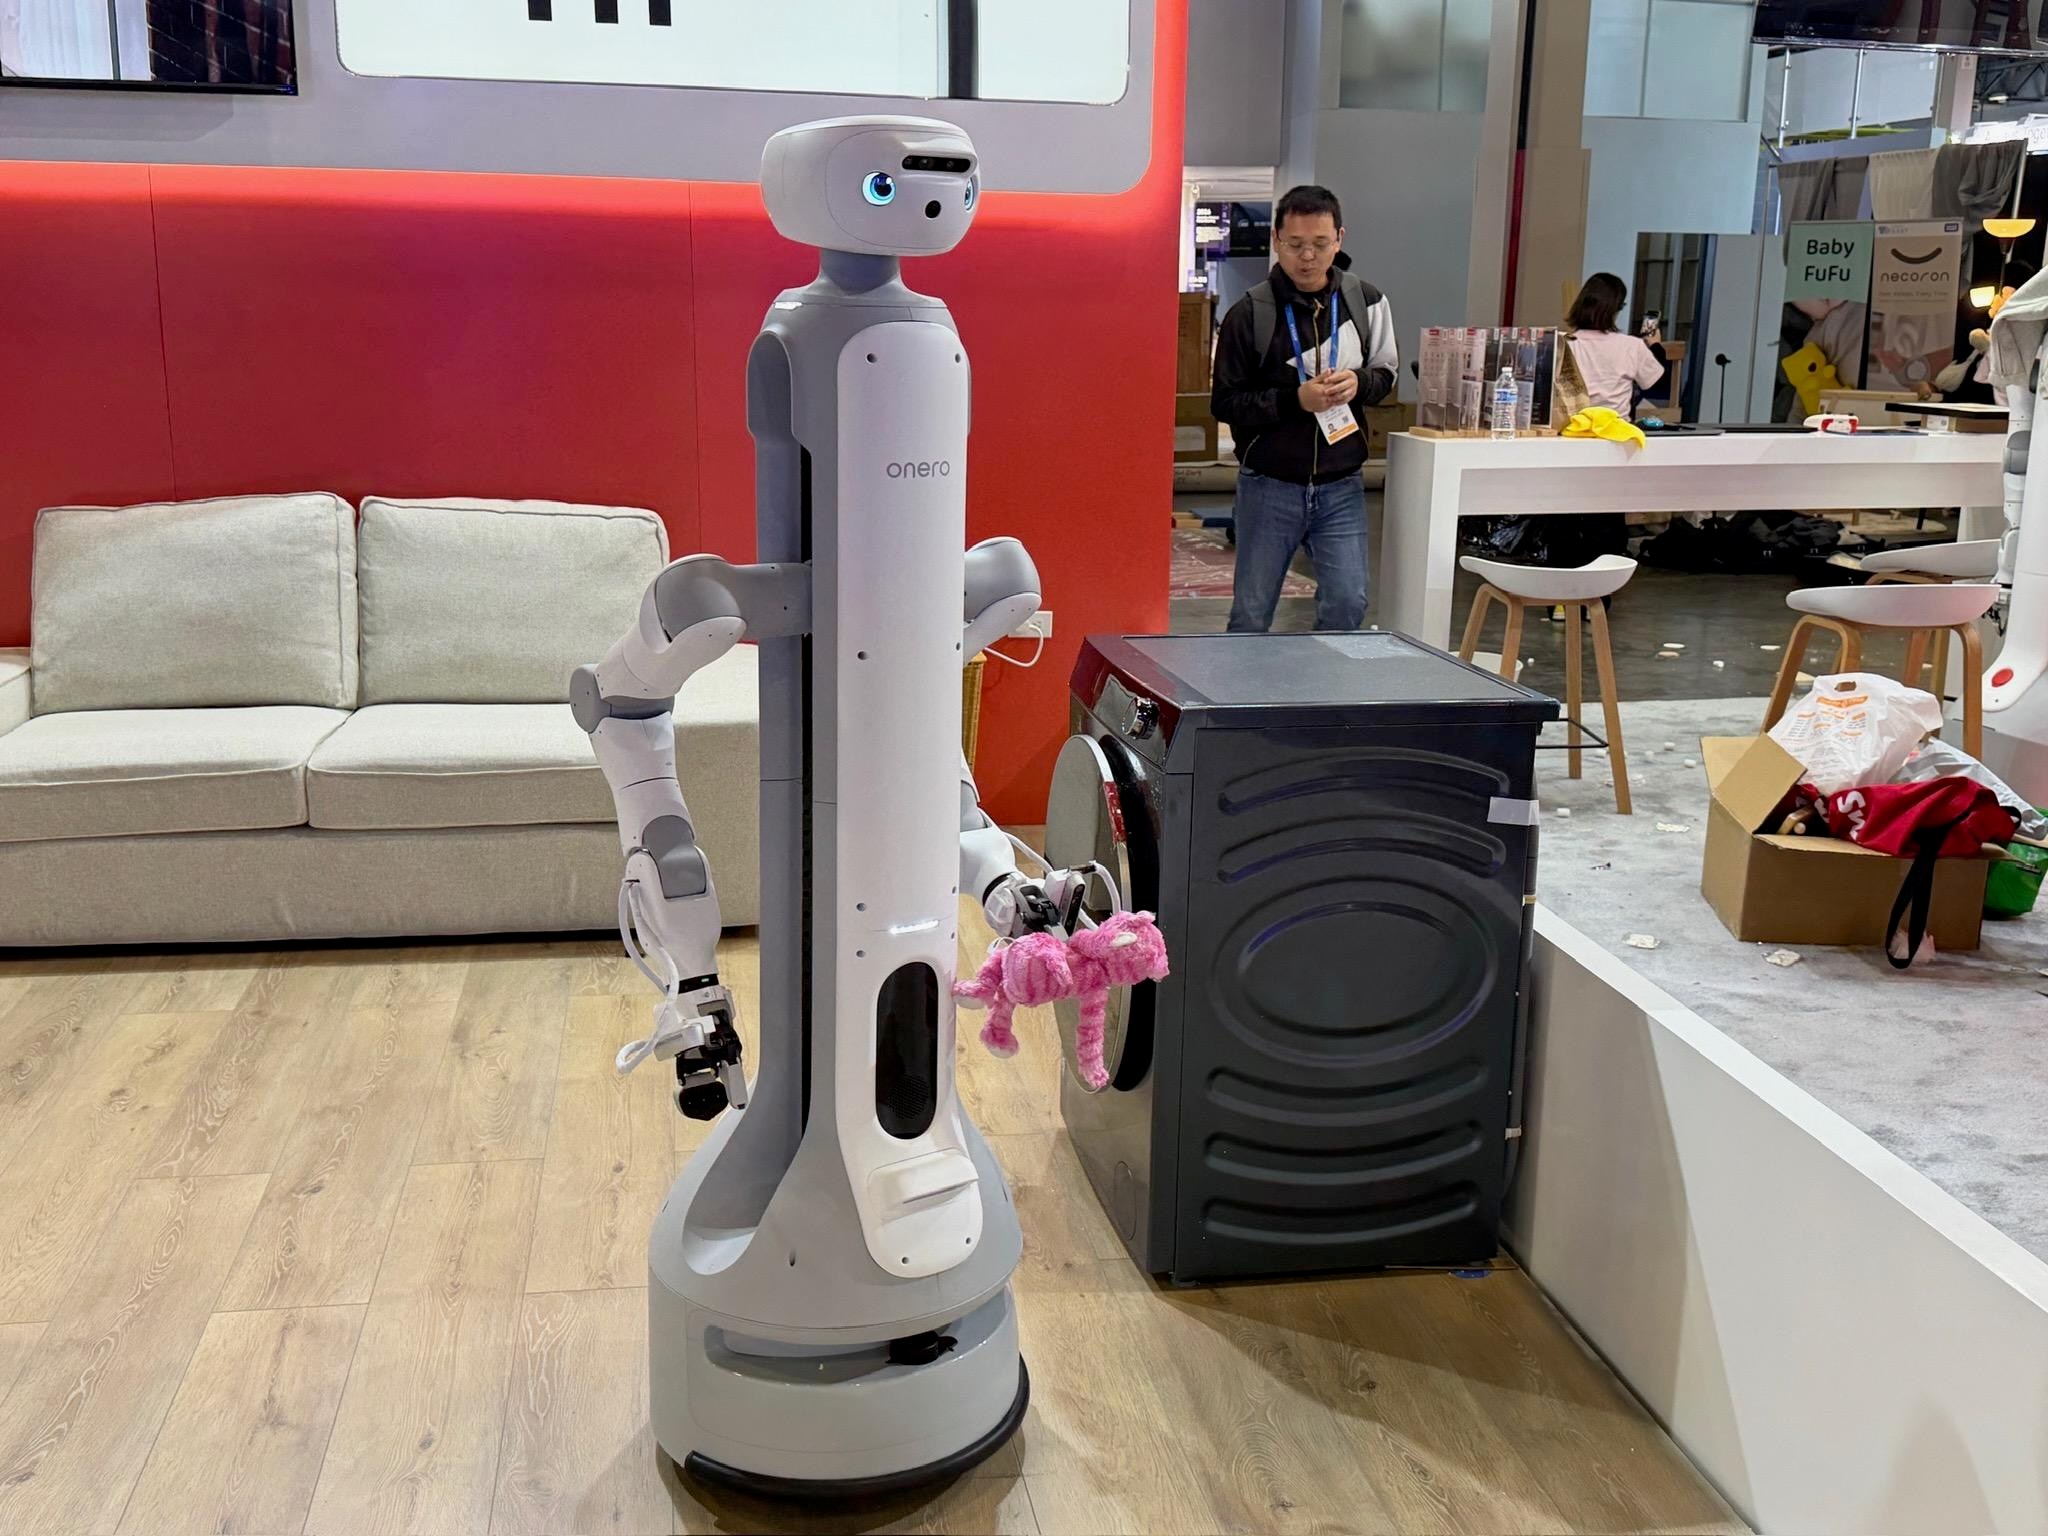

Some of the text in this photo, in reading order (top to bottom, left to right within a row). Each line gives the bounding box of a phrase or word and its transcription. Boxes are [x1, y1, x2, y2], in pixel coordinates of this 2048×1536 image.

[1806, 238, 1855, 258] Baby
[1804, 265, 1850, 282] FuFu
[1880, 271, 1950, 283] necoron
[886, 460, 950, 479] onero
